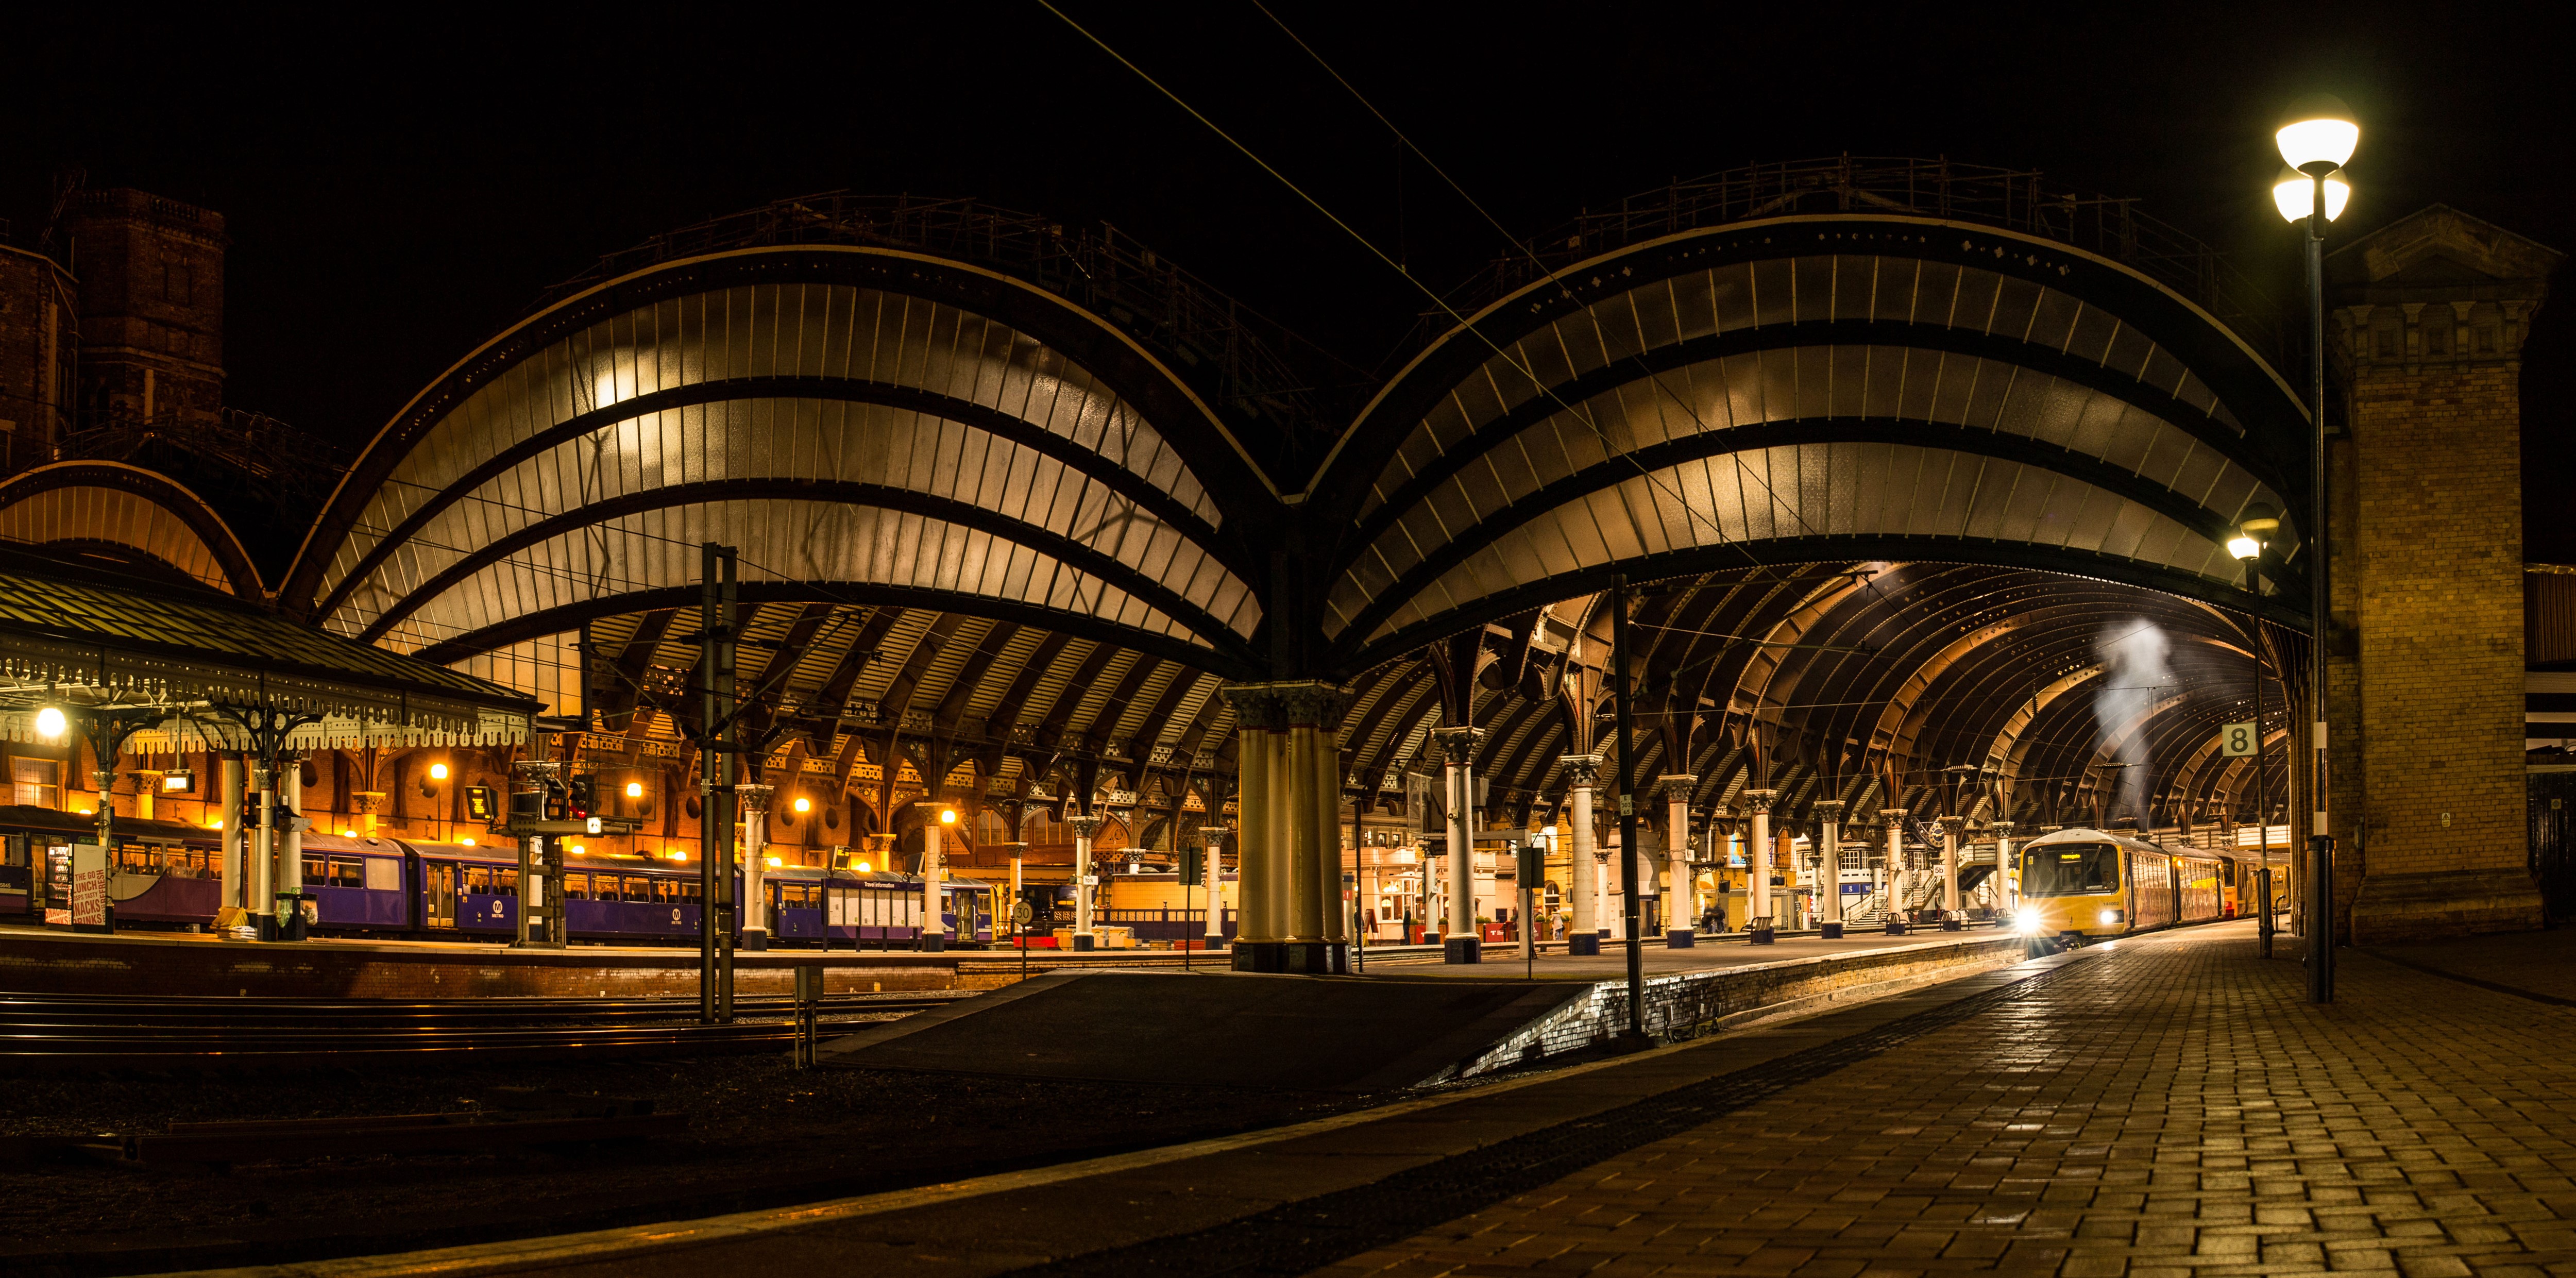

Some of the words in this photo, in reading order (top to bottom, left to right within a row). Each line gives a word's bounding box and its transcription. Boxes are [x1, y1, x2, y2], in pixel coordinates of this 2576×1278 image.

[2231, 728, 2248, 752] 8
[75, 873, 86, 881] THE
[87, 871, 96, 879] GO
[1017, 907, 1029, 918] 30
